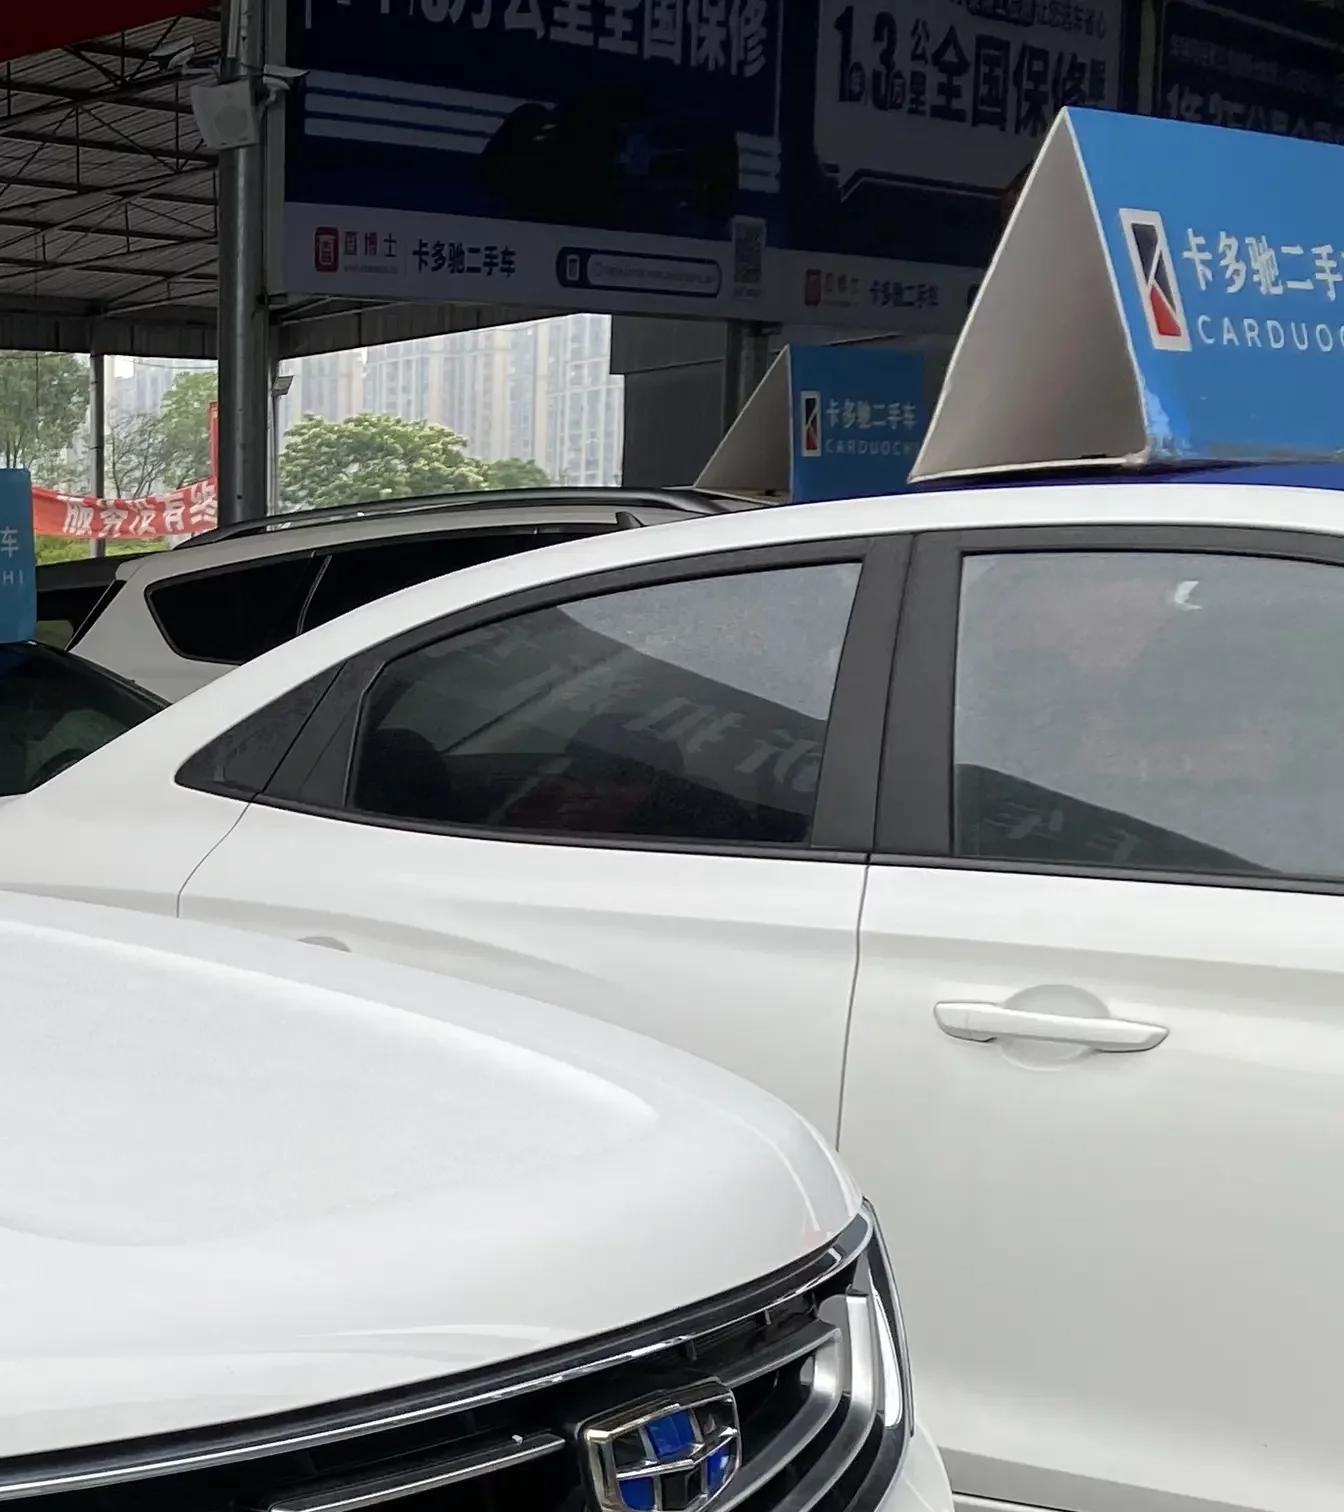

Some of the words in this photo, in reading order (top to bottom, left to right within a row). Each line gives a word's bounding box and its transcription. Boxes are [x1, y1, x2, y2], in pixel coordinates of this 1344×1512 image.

[412, 239, 516, 277] 卡多驰二手车
[1183, 228, 1344, 301] 卡多驰二手
[1198, 315, 1344, 351] CARDUO
